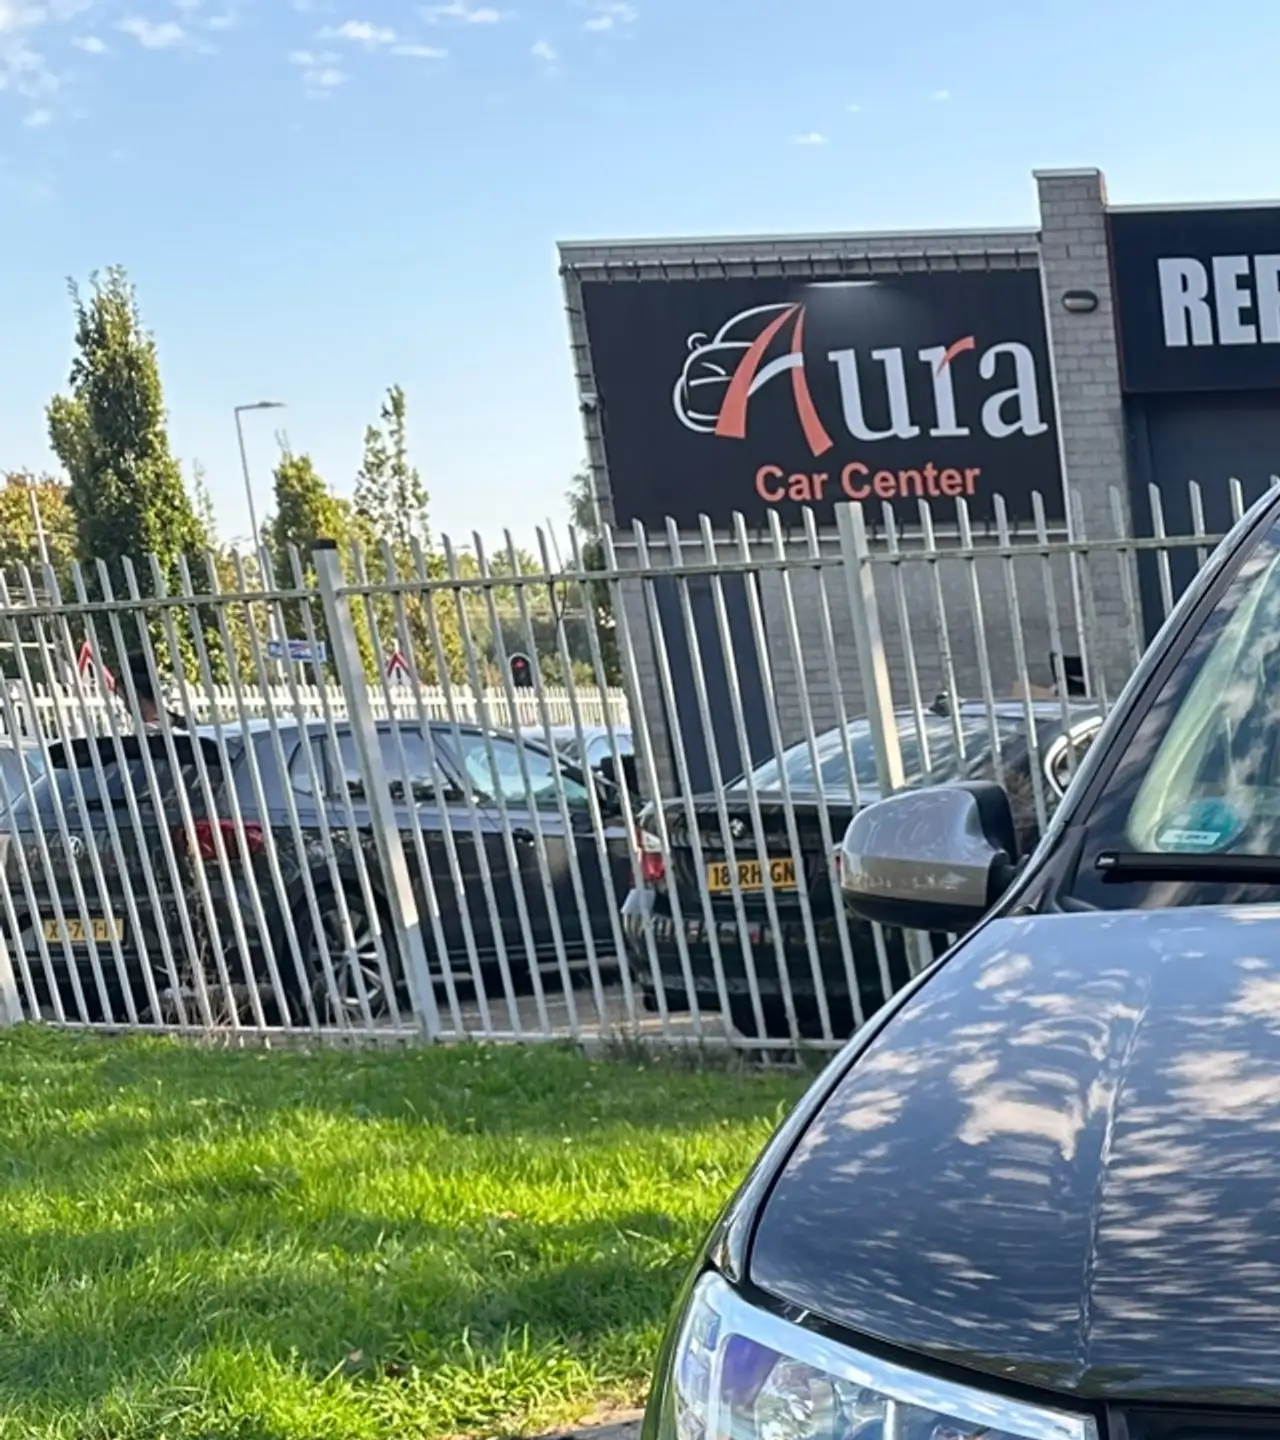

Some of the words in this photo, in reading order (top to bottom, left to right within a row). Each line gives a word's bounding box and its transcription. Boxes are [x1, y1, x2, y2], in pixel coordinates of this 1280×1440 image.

[714, 301, 1049, 457] Aura
[755, 464, 829, 502] Car
[841, 461, 981, 498] Center
